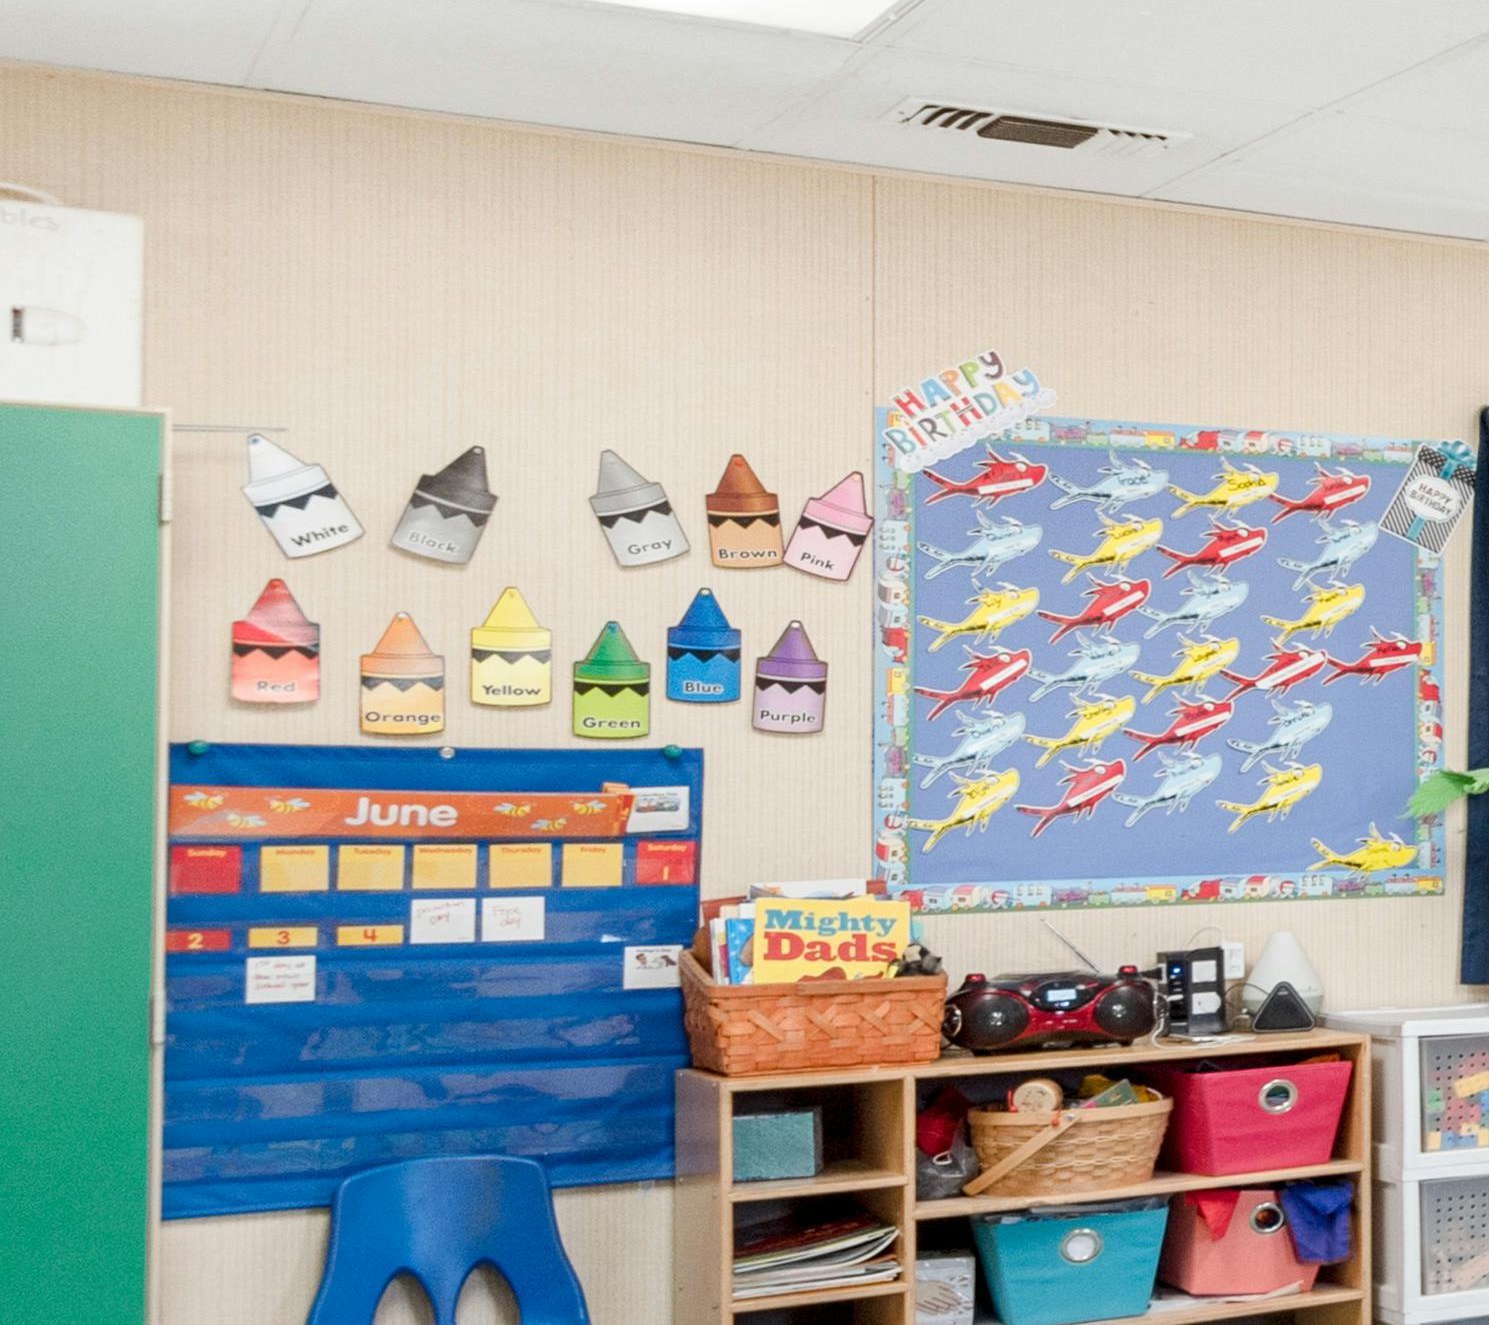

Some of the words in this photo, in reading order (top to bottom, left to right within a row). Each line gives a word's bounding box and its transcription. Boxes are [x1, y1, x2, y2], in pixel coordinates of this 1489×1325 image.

[894, 351, 1004, 418] HAPPY
[885, 369, 1041, 455] BIRTHDAY
[1409, 489, 1453, 515] BIRTHDAY
[1417, 482, 1454, 504] HAPPY
[290, 523, 350, 547] White
[408, 531, 460, 554] Black
[627, 538, 673, 556] Gray
[718, 548, 778, 560] Brown
[800, 551, 836, 571] Pink
[256, 680, 296, 693] Red
[482, 684, 542, 696] Yellow
[684, 681, 723, 694] Blue
[364, 711, 442, 725] Orange
[582, 716, 641, 729] Green
[760, 710, 817, 725] Purple
[344, 796, 459, 827] June
[186, 848, 227, 859] Sunday
[275, 847, 316, 857] Monday
[353, 847, 392, 857] Tuesday
[418, 846, 473, 855] Wednesday
[500, 846, 542, 855] Thursday
[580, 845, 608, 855] Friday
[646, 842, 688, 853] Saturday
[662, 866, 669, 881] 1
[764, 909, 897, 937] Mighty
[187, 932, 205, 950] 2
[276, 930, 291, 945] 3
[362, 928, 378, 942] 4
[763, 931, 898, 963] Dads
